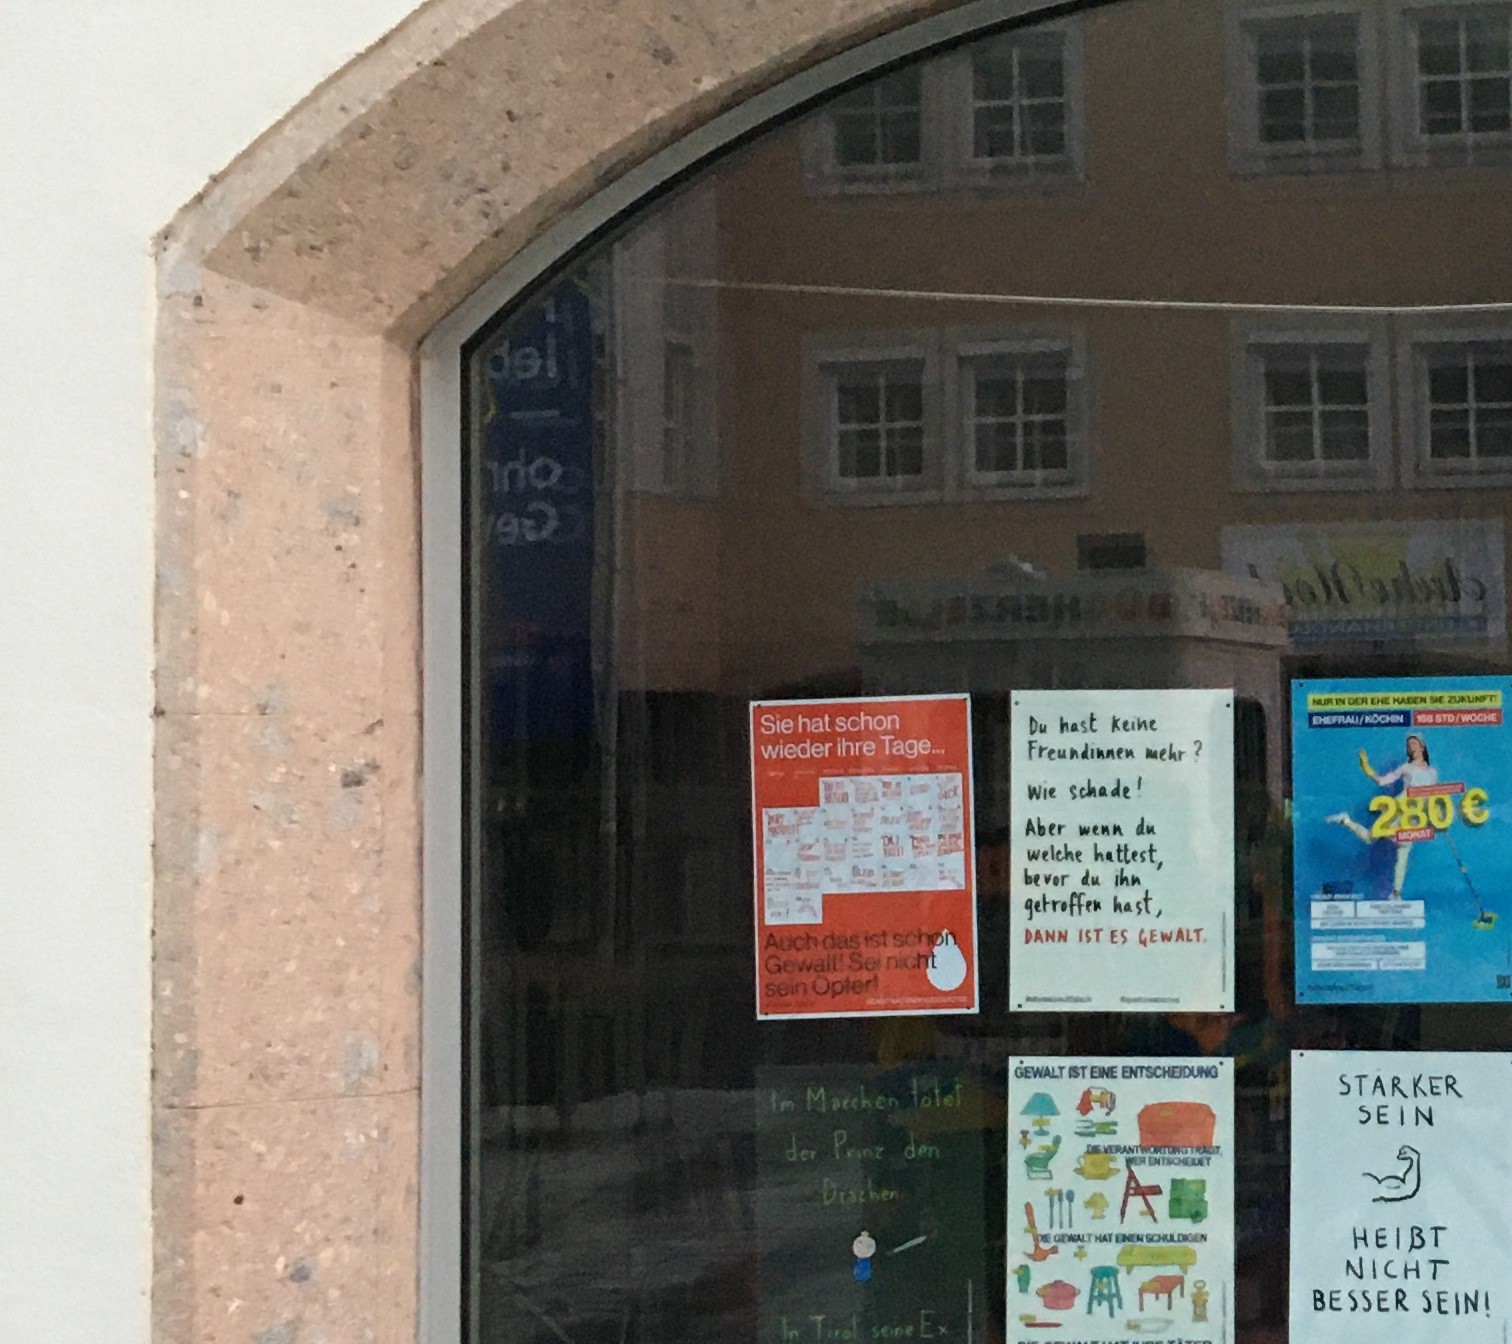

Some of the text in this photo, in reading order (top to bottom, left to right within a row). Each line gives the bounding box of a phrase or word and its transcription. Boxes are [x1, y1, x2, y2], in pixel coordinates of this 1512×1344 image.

[1370, 696, 1391, 706] EHE
[760, 711, 900, 735] Sie hat schon
[1029, 712, 1158, 736] Du hast keine
[760, 735, 945, 759] wieder ihre Tage...
[1027, 739, 1135, 762] Freundinnen
[1368, 793, 1455, 839] 280
[1025, 819, 1157, 838] Aber wenn du
[1027, 842, 1083, 863] welche
[1024, 867, 1142, 887] bevor du ihn
[1024, 889, 1163, 921] getroffen hast,
[764, 927, 958, 951] Auch das ist schon
[1024, 927, 1207, 947] DANN IST ES GEWALT.
[886, 951, 938, 971] nicht
[764, 978, 808, 998] sein
[1014, 1064, 1220, 1080] GEWALT IST EINE ENTSCHEIDUNG
[769, 1089, 796, 1113] Im
[1358, 1104, 1435, 1127] SEIN
[785, 1128, 941, 1163] der Prinz den
[821, 1176, 900, 1206] Drachen
[1053, 1232, 1092, 1244] GEWALT
[1094, 1232, 1113, 1244] HAT
[1114, 1232, 1144, 1244] EINEN
[1145, 1232, 1208, 1244] SCHULDIGEN
[1345, 1258, 1450, 1282] NICHT
[1311, 1288, 1493, 1319] BESSER SEIN!
[871, 1321, 915, 1340] seine
[920, 1308, 950, 1340] Ex
